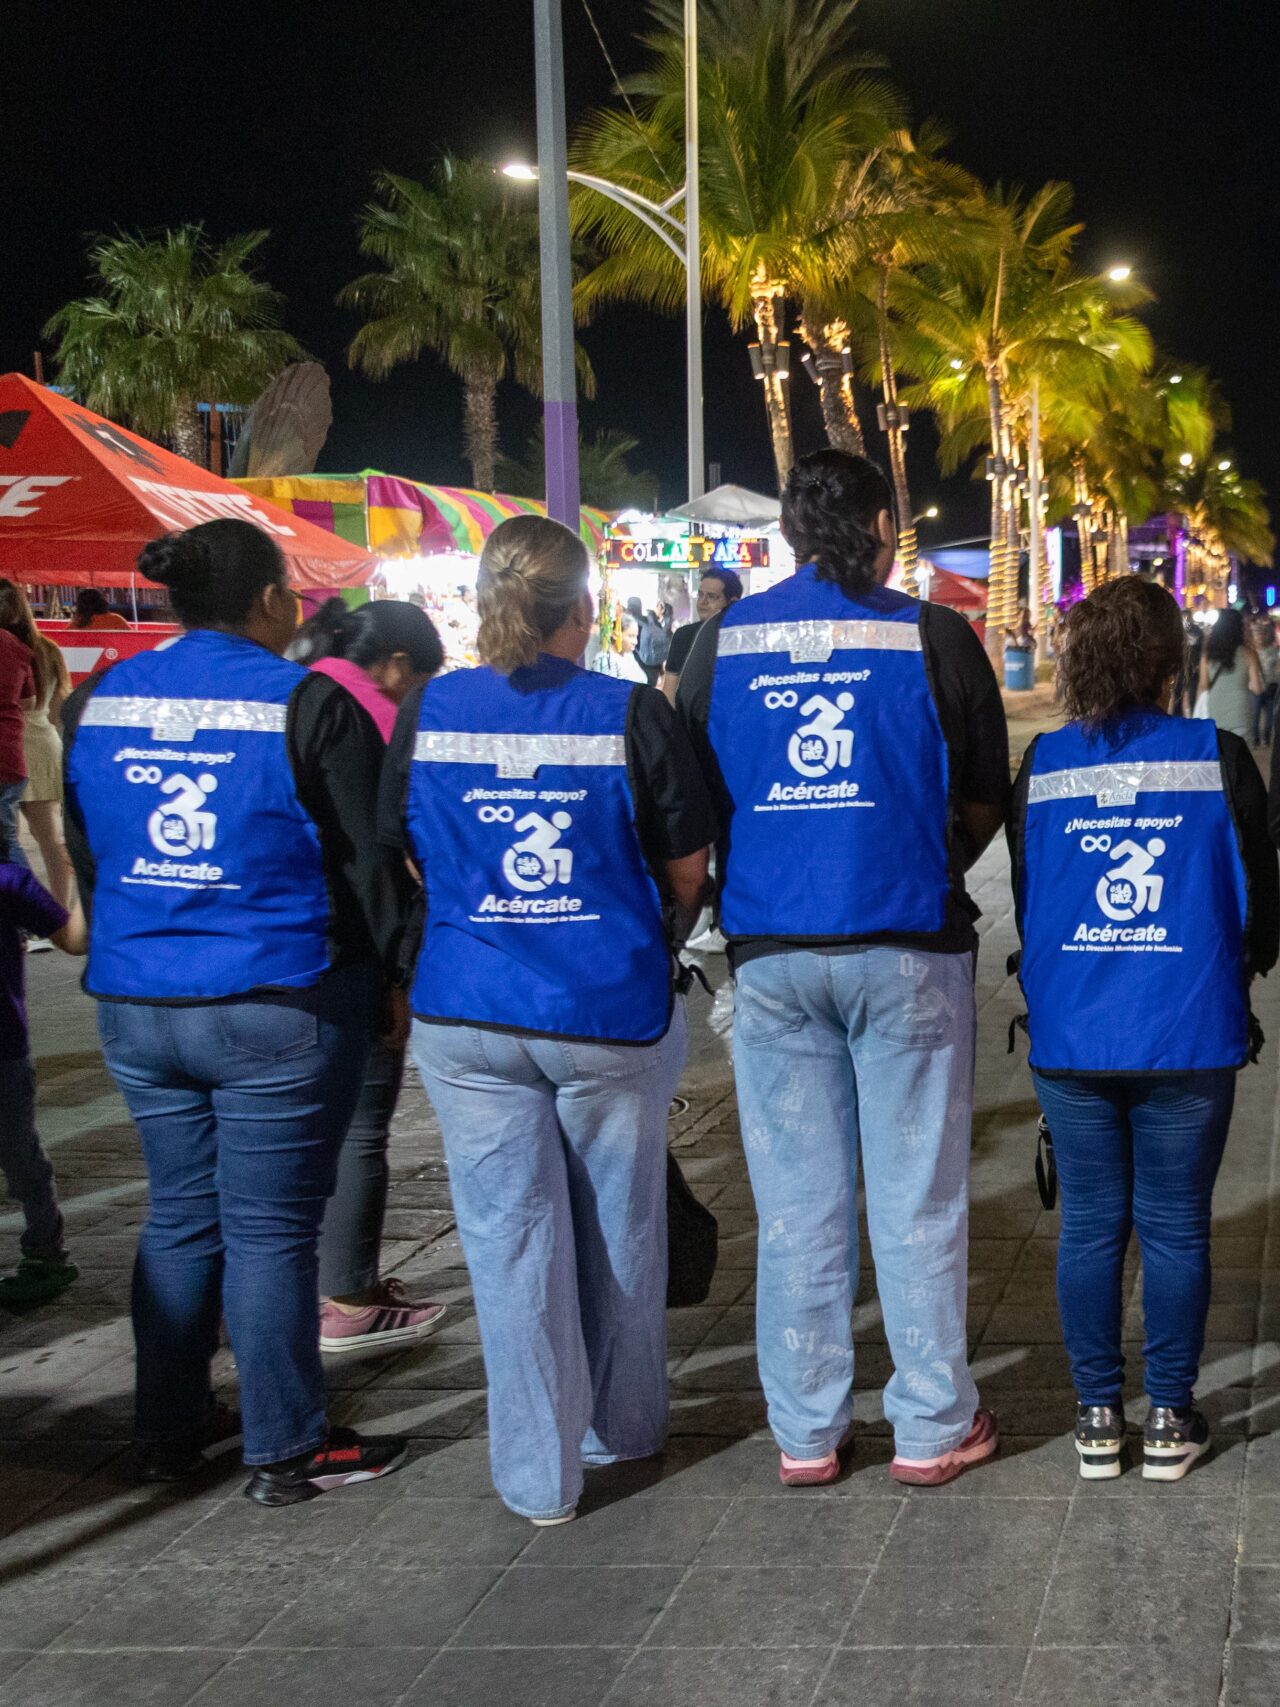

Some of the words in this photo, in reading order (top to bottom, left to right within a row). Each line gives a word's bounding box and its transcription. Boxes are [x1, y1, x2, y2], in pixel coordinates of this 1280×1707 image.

[621, 541, 693, 562] COLLAR
[702, 541, 751, 562] PARA
[749, 671, 820, 690] ¿Necesitas
[822, 669, 871, 684] apoyo?
[462, 788, 536, 803] ¿Necesitas
[538, 789, 588, 803] apoyo?
[767, 780, 859, 801] Acércate
[1064, 816, 1132, 834] ¿Necesitas
[1133, 814, 1183, 830] apoyo?
[478, 894, 582, 914] Acércate
[1073, 923, 1168, 942] Acércate
